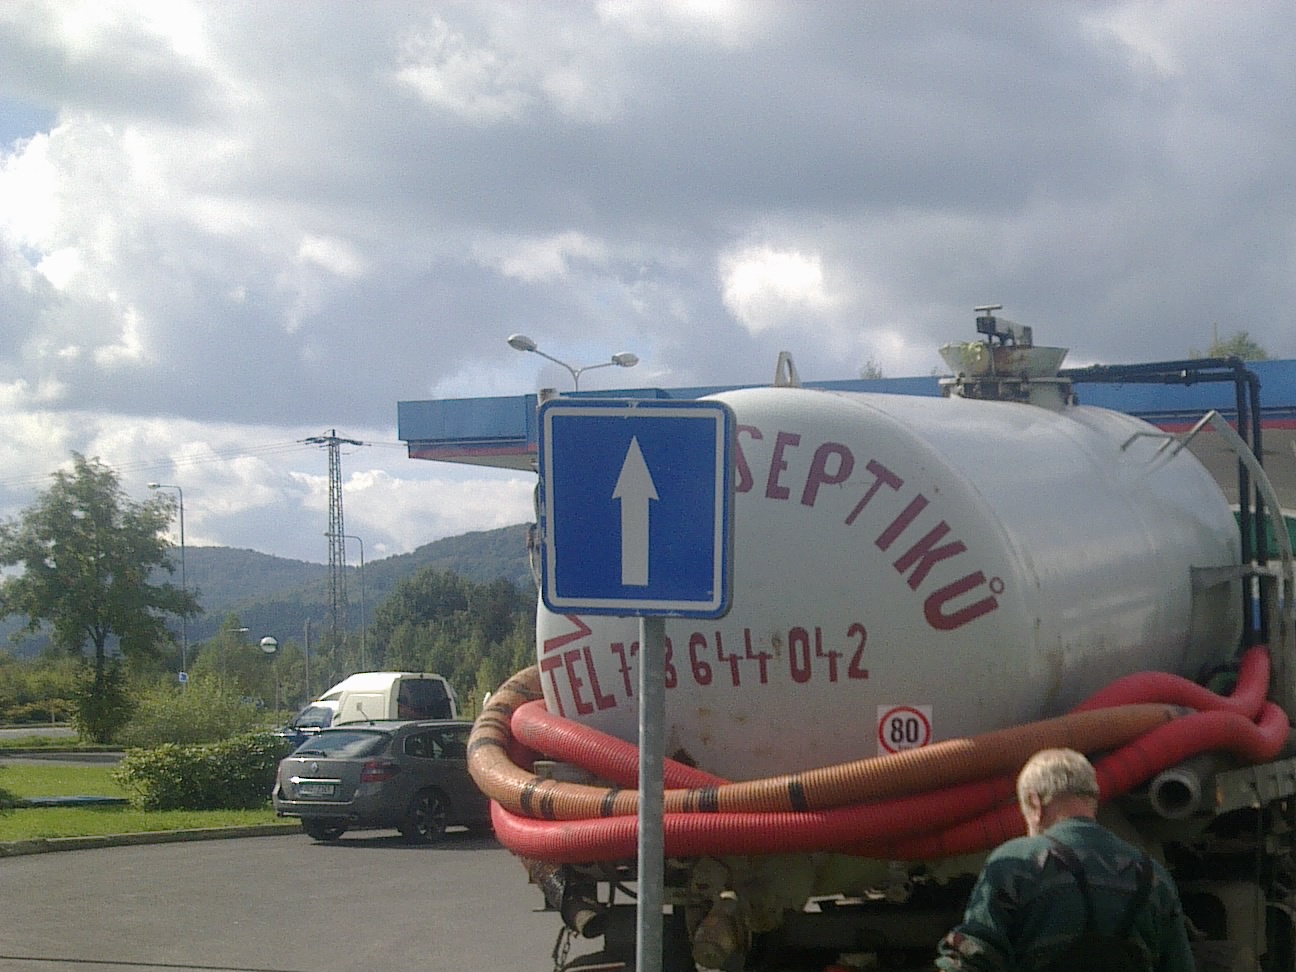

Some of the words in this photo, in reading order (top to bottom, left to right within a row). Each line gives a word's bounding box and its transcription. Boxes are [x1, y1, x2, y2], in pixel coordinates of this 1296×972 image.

[736, 424, 1004, 631] SEPTIKŮ
[541, 646, 616, 717] TEL
[891, 717, 919, 743] 80
